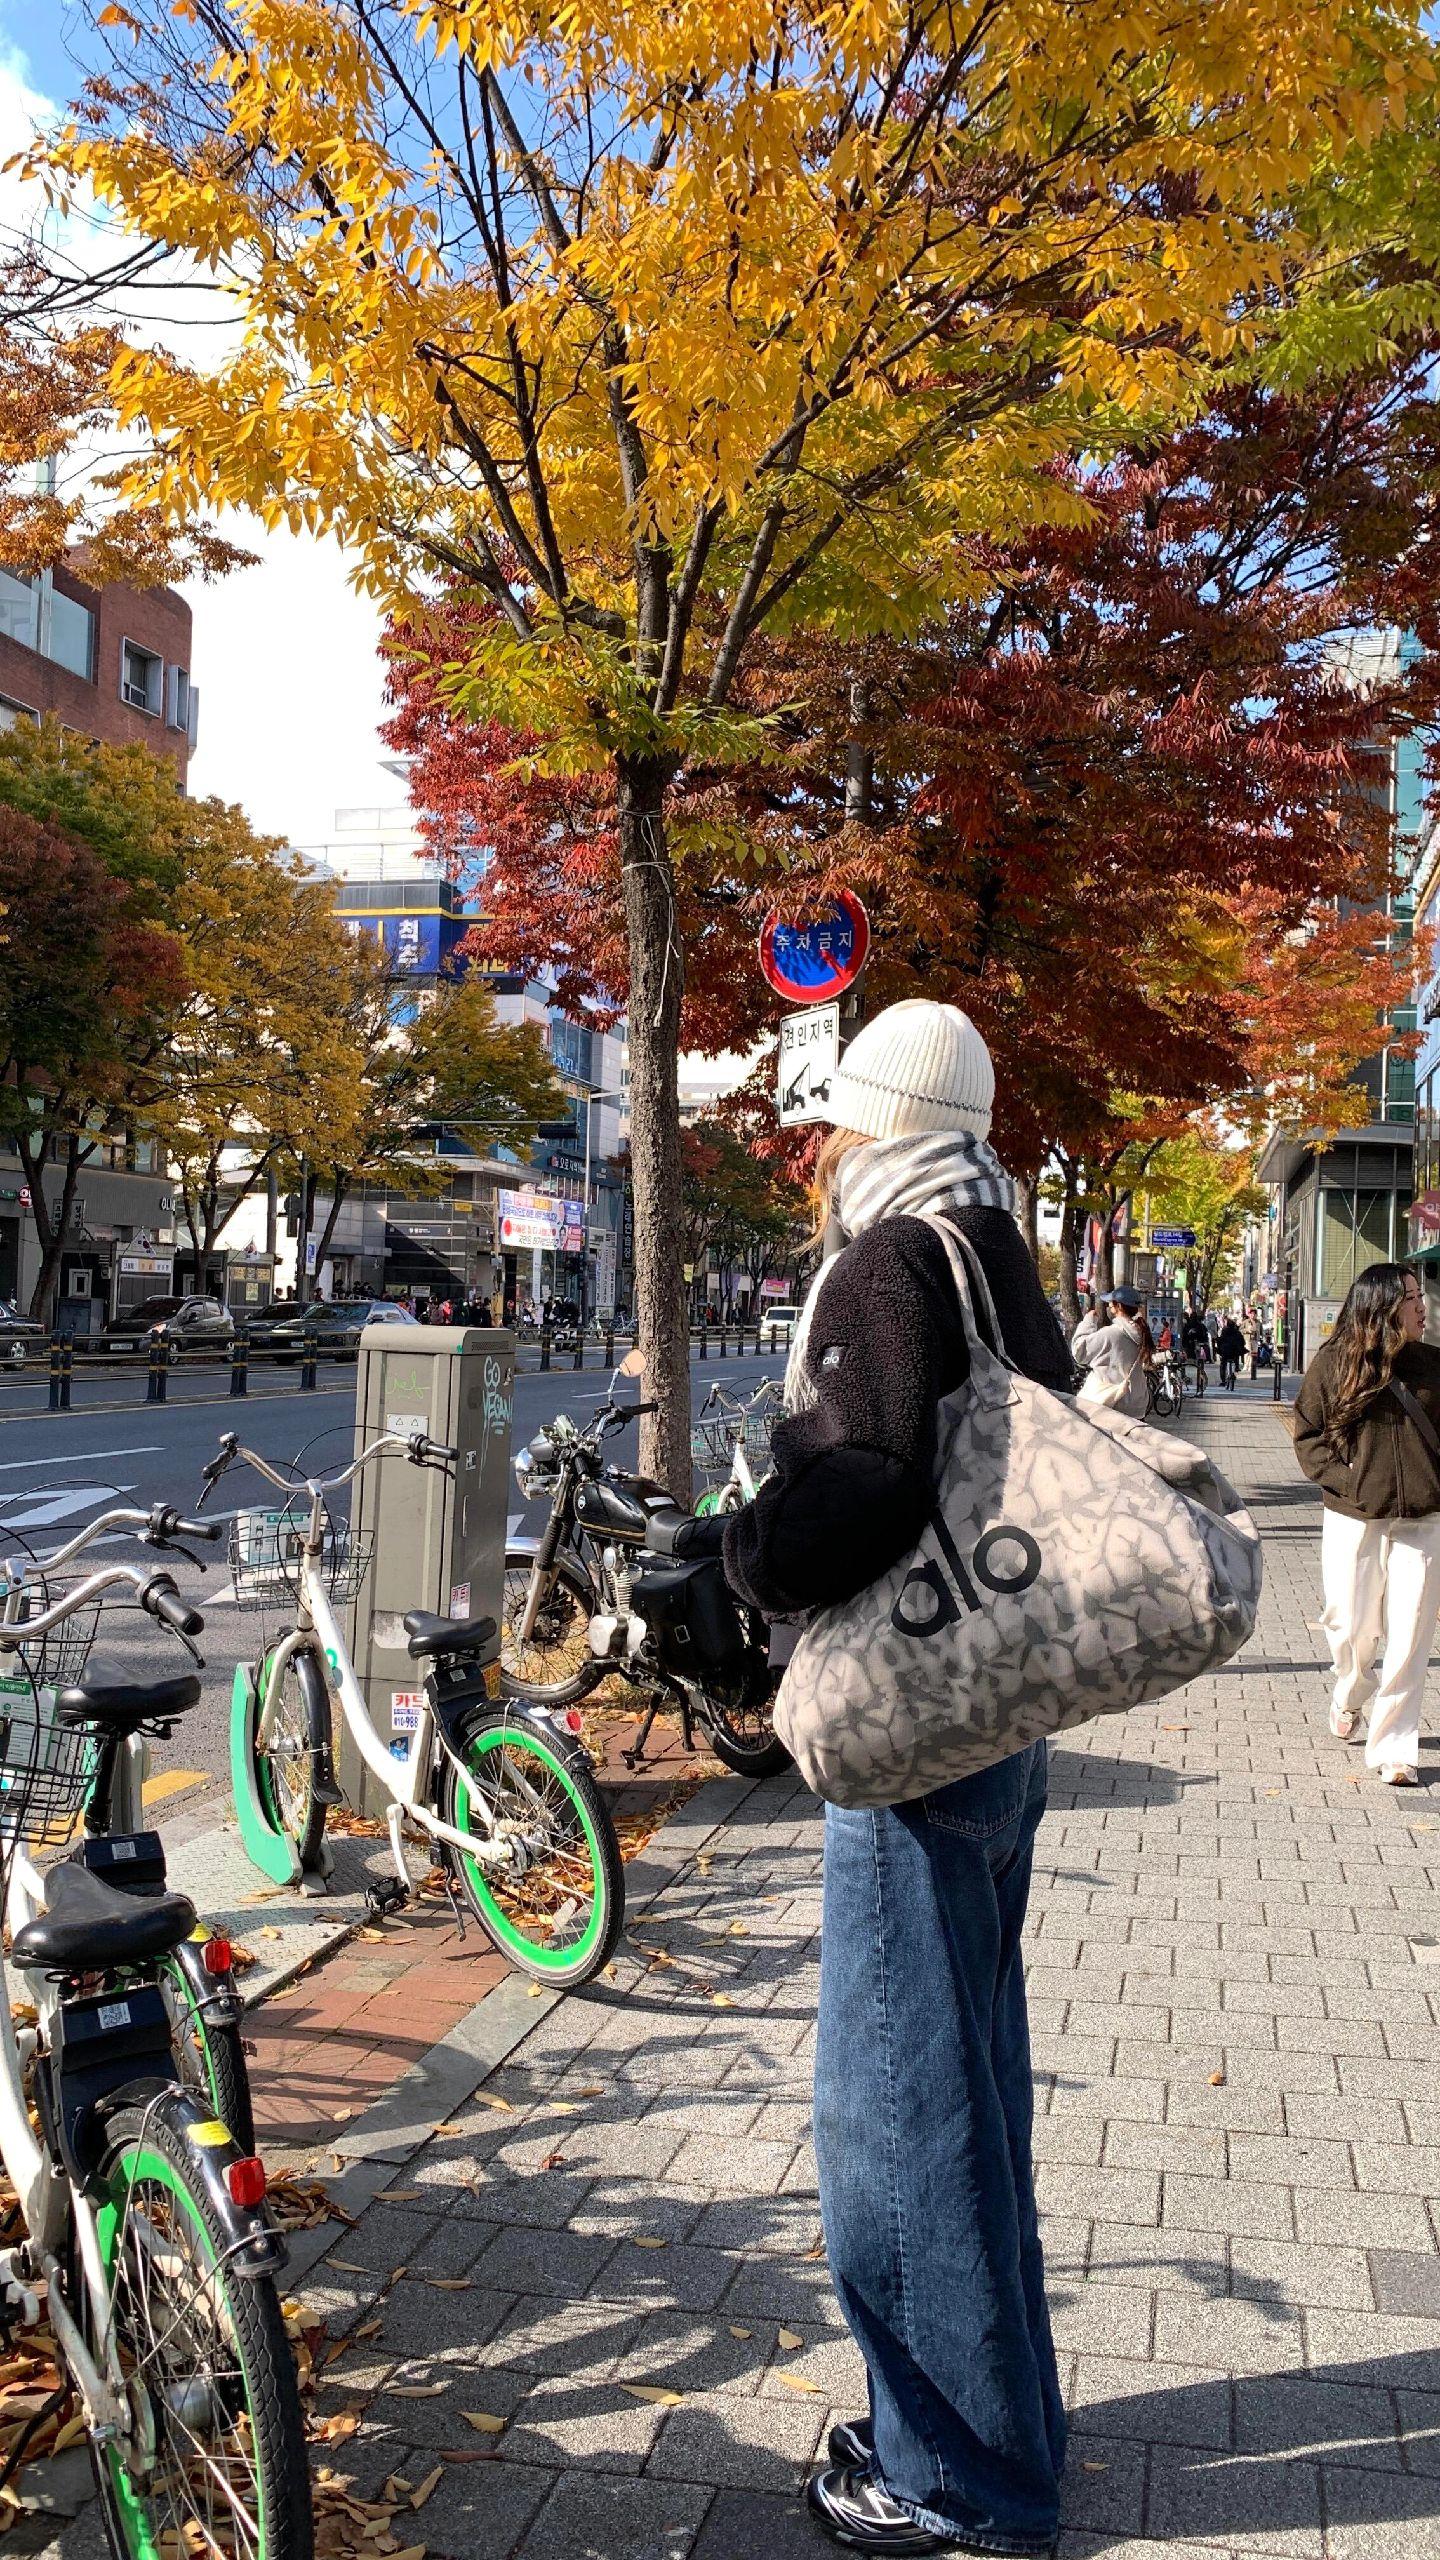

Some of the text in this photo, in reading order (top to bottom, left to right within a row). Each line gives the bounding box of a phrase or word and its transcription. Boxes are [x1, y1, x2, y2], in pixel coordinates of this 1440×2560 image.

[776, 929, 853, 952] 주차금지
[783, 1018, 834, 1050] 견인지역
[484, 1355, 500, 1388] GO
[822, 1351, 840, 1365] alo
[483, 1389, 513, 1424] VEGAN
[891, 1508, 1042, 1638] alo
[395, 1695, 424, 1707] 카드
